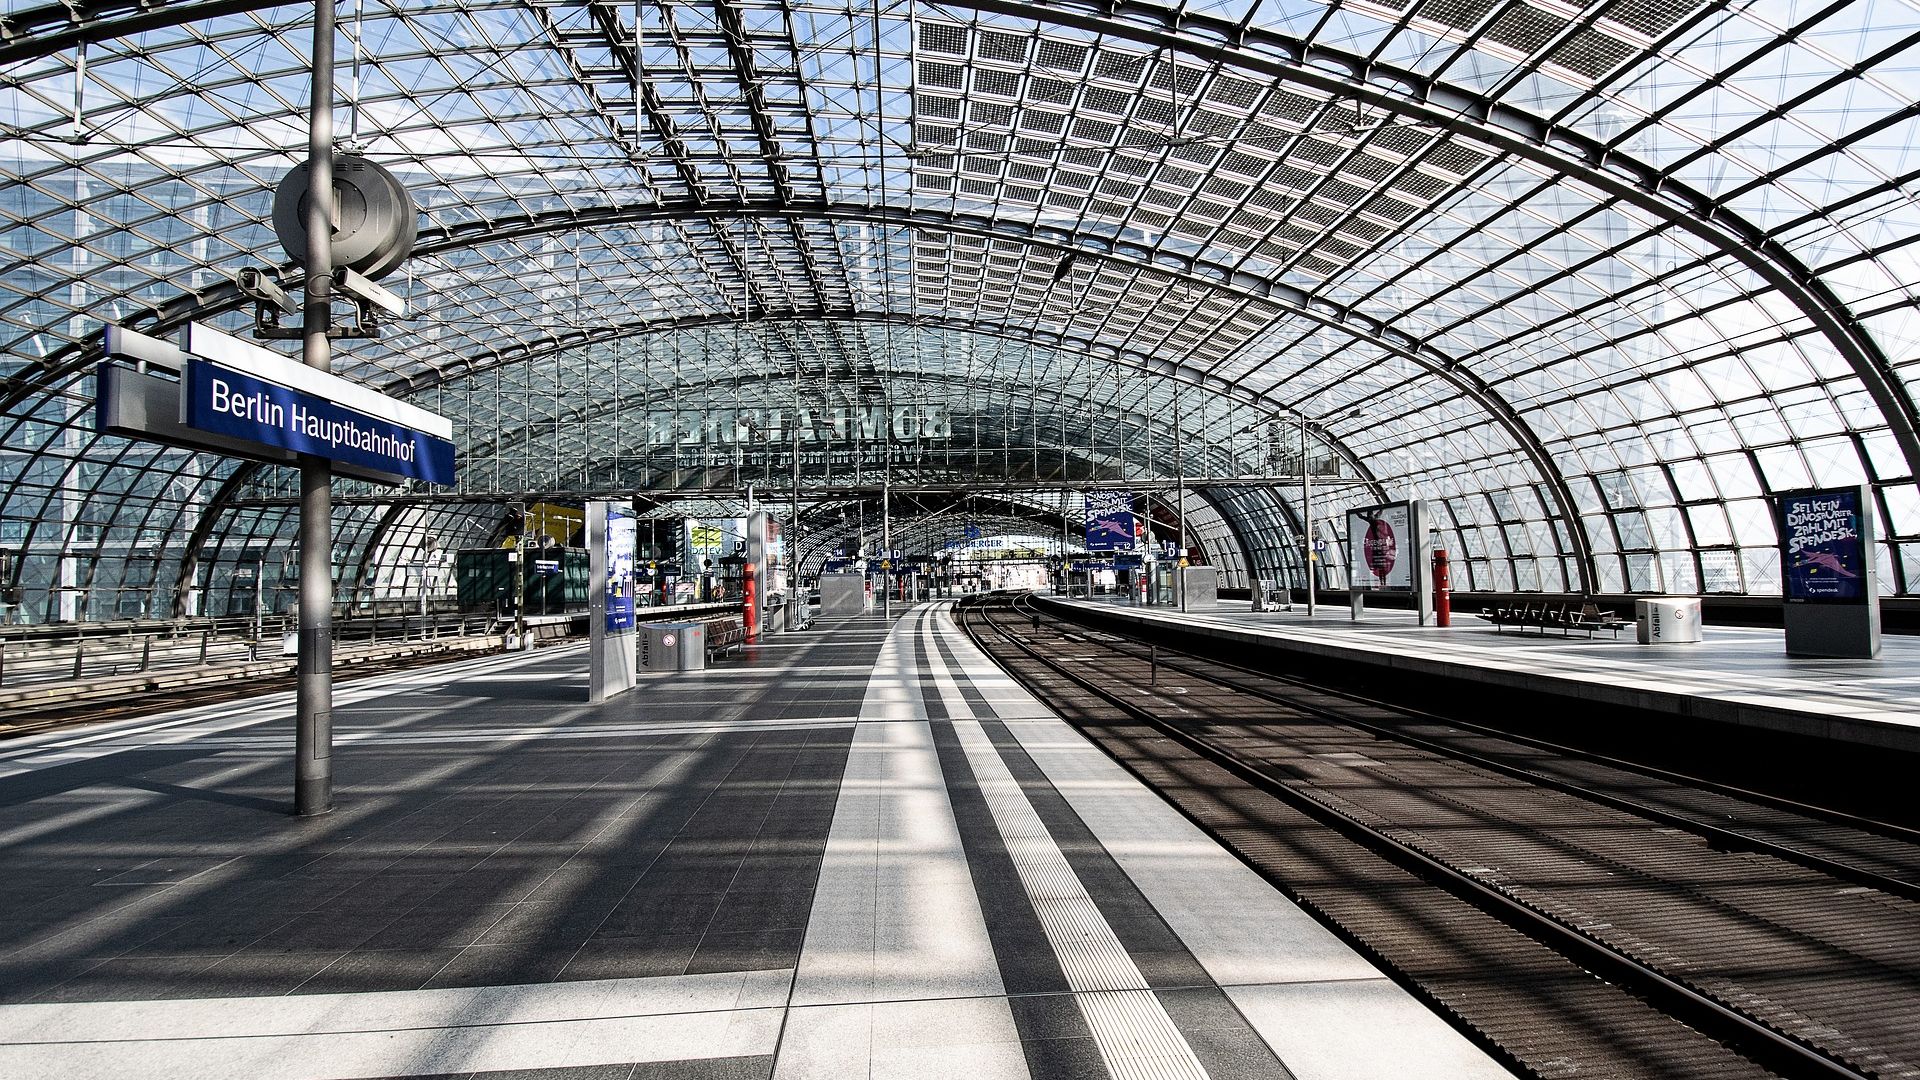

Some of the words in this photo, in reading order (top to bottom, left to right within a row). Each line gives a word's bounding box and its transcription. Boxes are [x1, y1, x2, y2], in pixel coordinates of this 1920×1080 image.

[212, 378, 284, 428] Berlin
[292, 404, 415, 462] Hauptbahnhof
[1111, 498, 1128, 507] MIT
[1792, 503, 1810, 514] SEI
[1812, 500, 1839, 512] KEIN
[1793, 523, 1823, 536] ZAHL
[1823, 518, 1847, 530] MIT
[735, 542, 743, 551] D
[1317, 541, 1325, 550] D
[692, 547, 721, 555] DAEV
[893, 549, 901, 558] D
[1168, 548, 1176, 557] D
[1651, 613, 1661, 638] Abfall
[641, 640, 649, 667] Abfall
